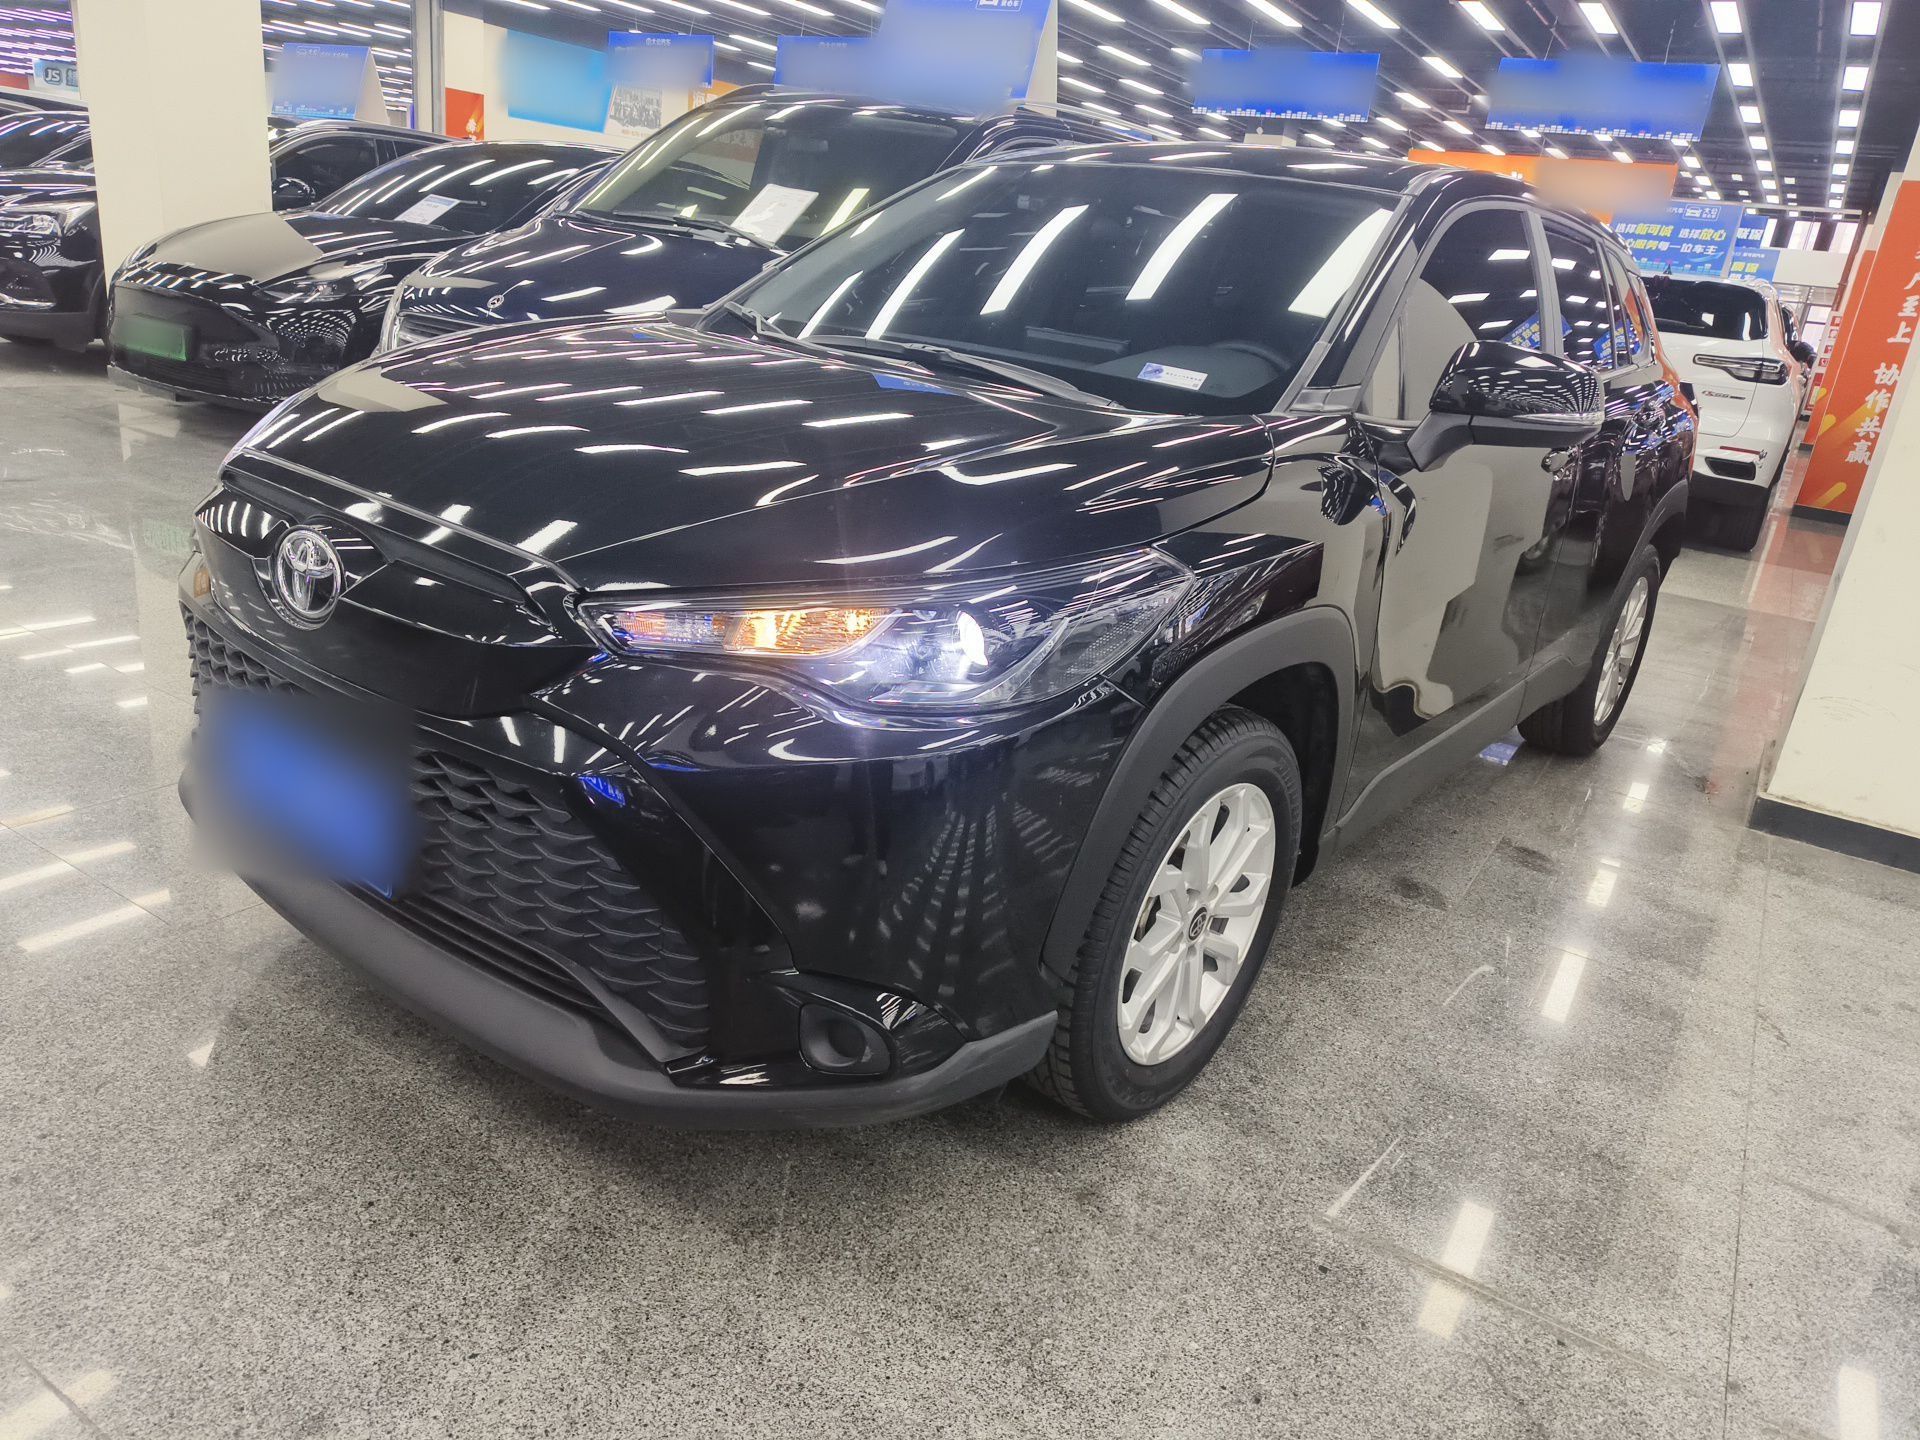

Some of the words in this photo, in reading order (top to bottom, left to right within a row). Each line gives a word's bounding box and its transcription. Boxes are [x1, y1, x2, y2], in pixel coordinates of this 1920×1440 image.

[46, 69, 60, 81] JS
[1678, 228, 1726, 241] 选择放心
[1845, 362, 1901, 466] 协作共赢
